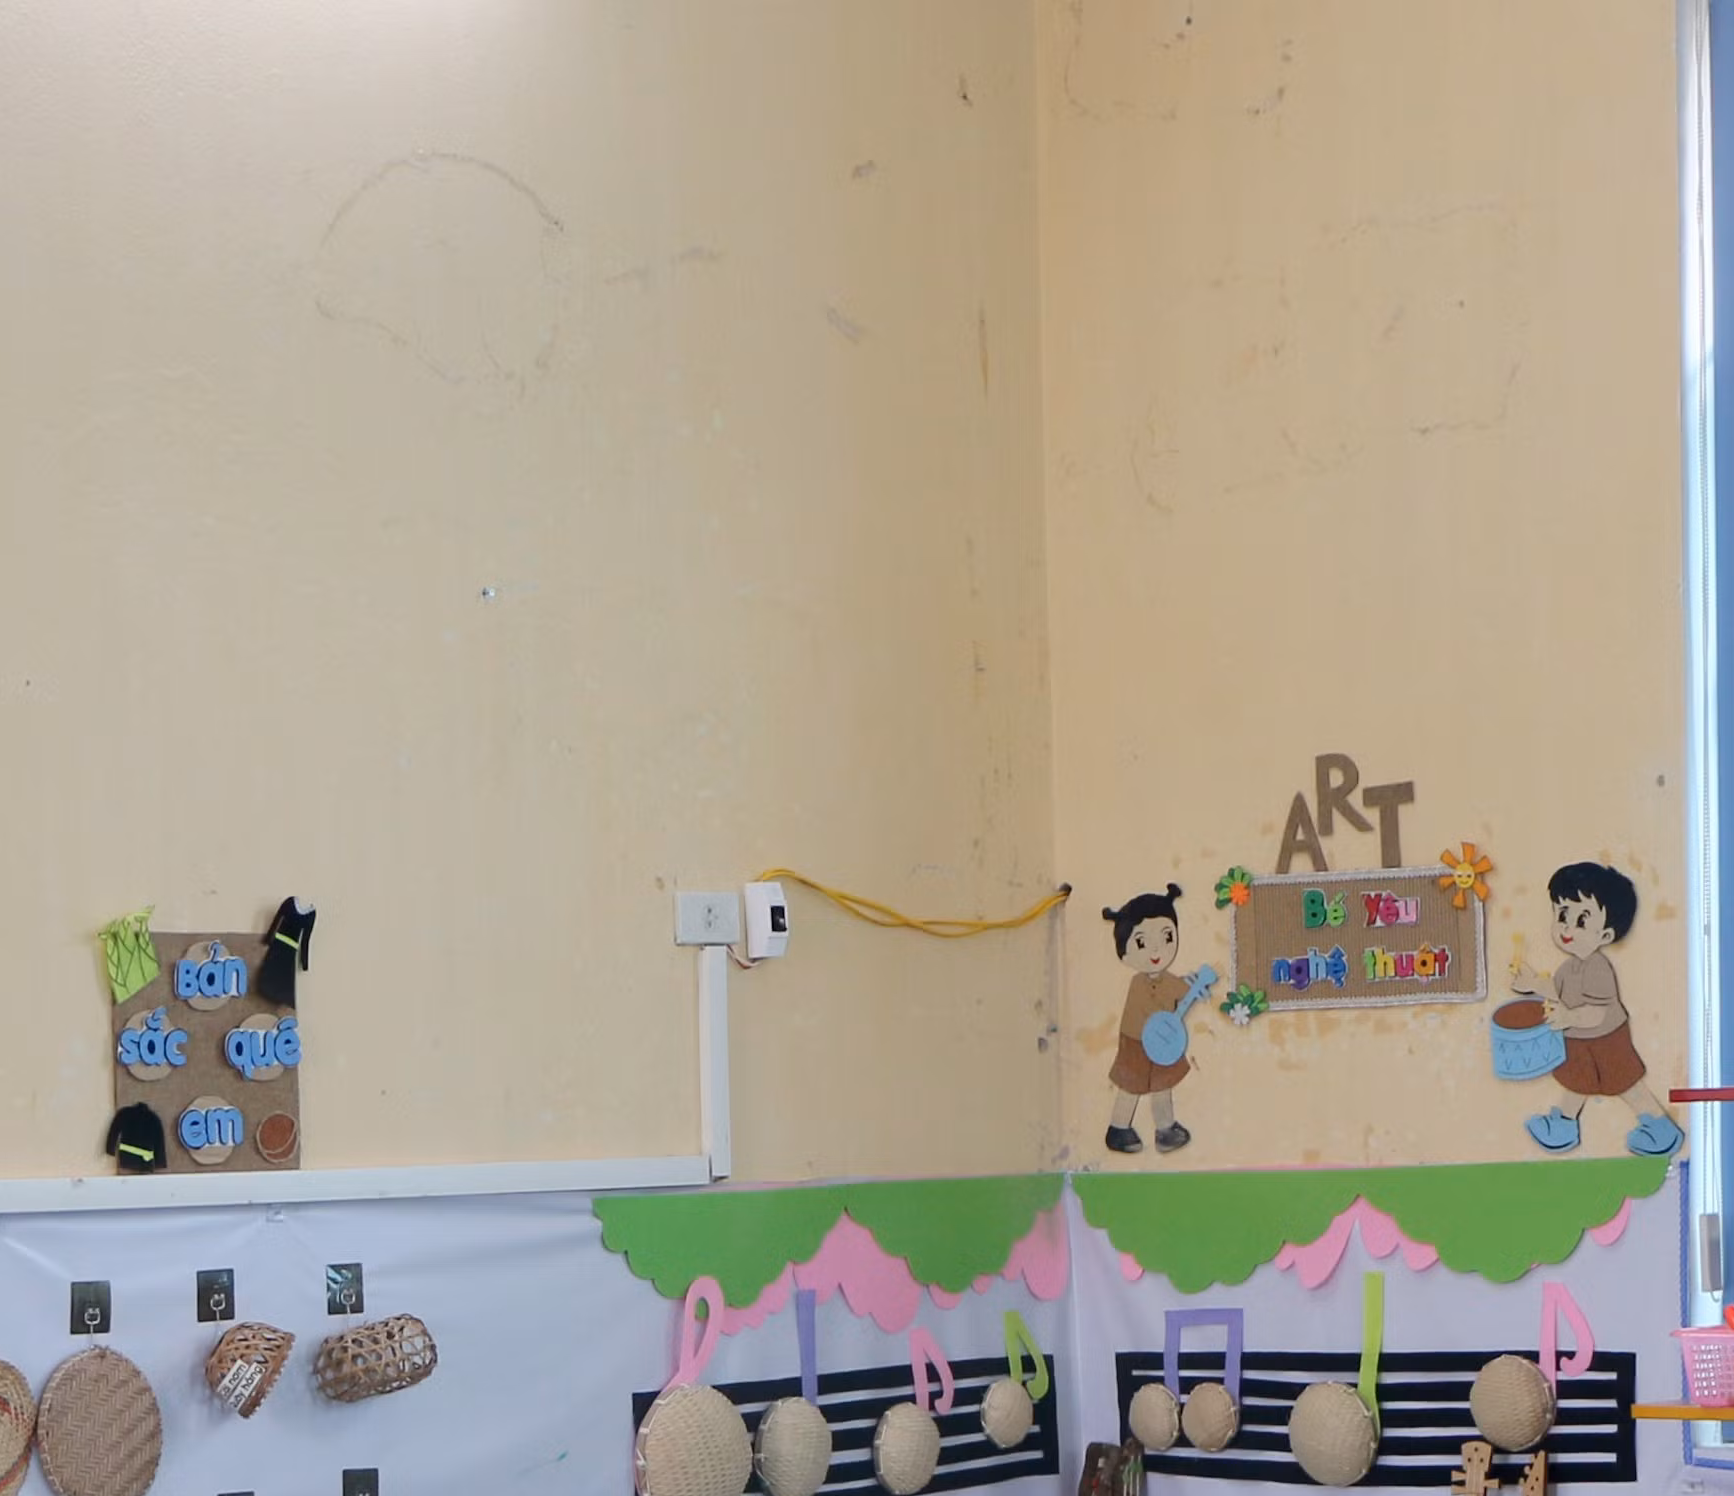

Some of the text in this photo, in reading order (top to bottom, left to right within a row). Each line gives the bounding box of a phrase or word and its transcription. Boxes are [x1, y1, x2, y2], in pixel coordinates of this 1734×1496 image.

[1275, 753, 1415, 874] ART
[1303, 888, 1347, 928] Bé
[175, 940, 248, 999] Bản
[1272, 943, 1450, 990] nghệ thuật
[119, 1007, 188, 1067] sắc
[178, 1108, 244, 1149] em
